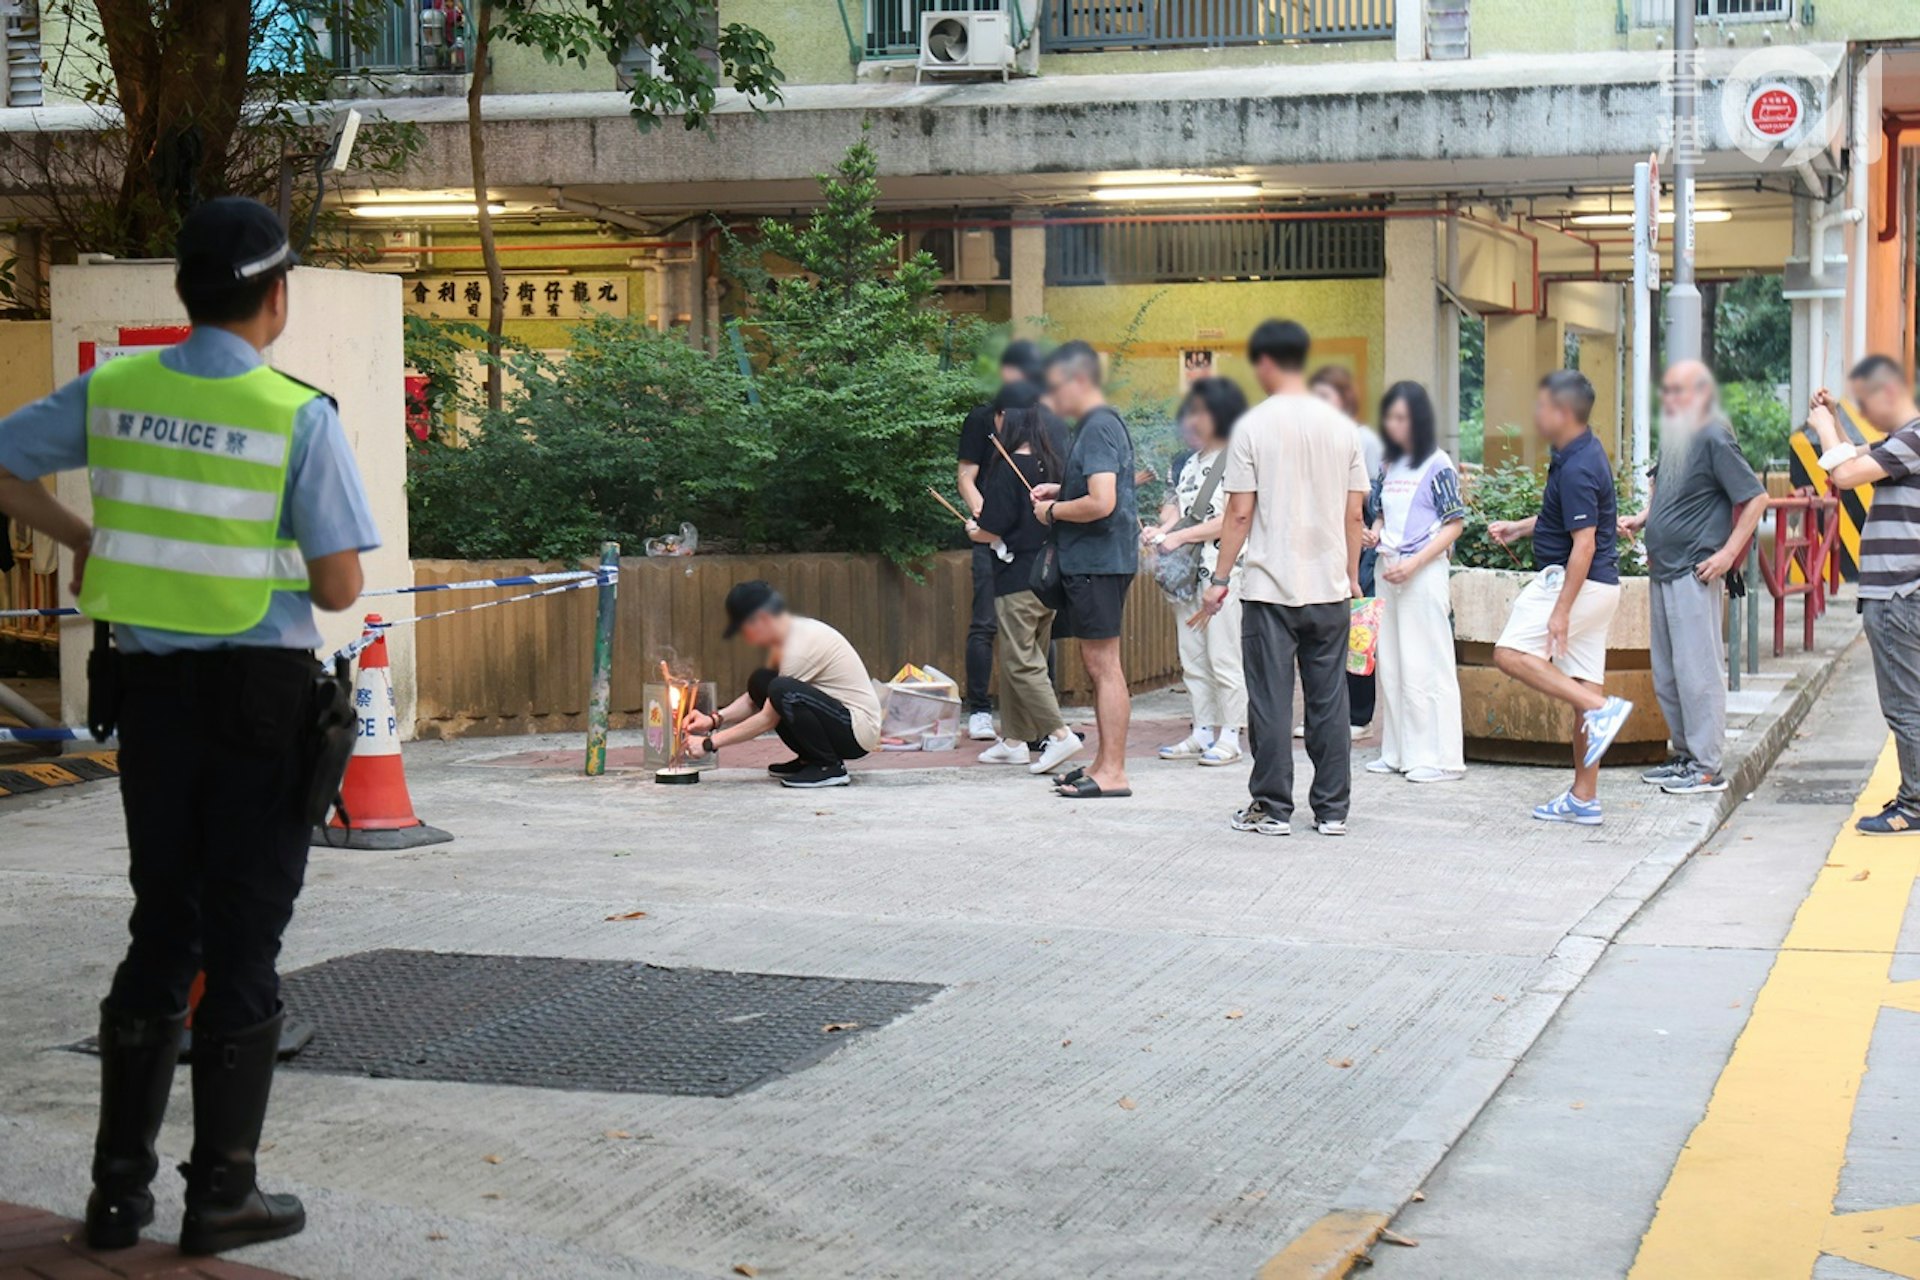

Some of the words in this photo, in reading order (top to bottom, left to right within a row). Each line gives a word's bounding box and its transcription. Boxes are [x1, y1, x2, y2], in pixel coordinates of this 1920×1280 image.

[467, 303, 560, 317] 有限司
[117, 413, 134, 437] 警
[140, 416, 216, 449] POLICE
[225, 431, 247, 454] 察
